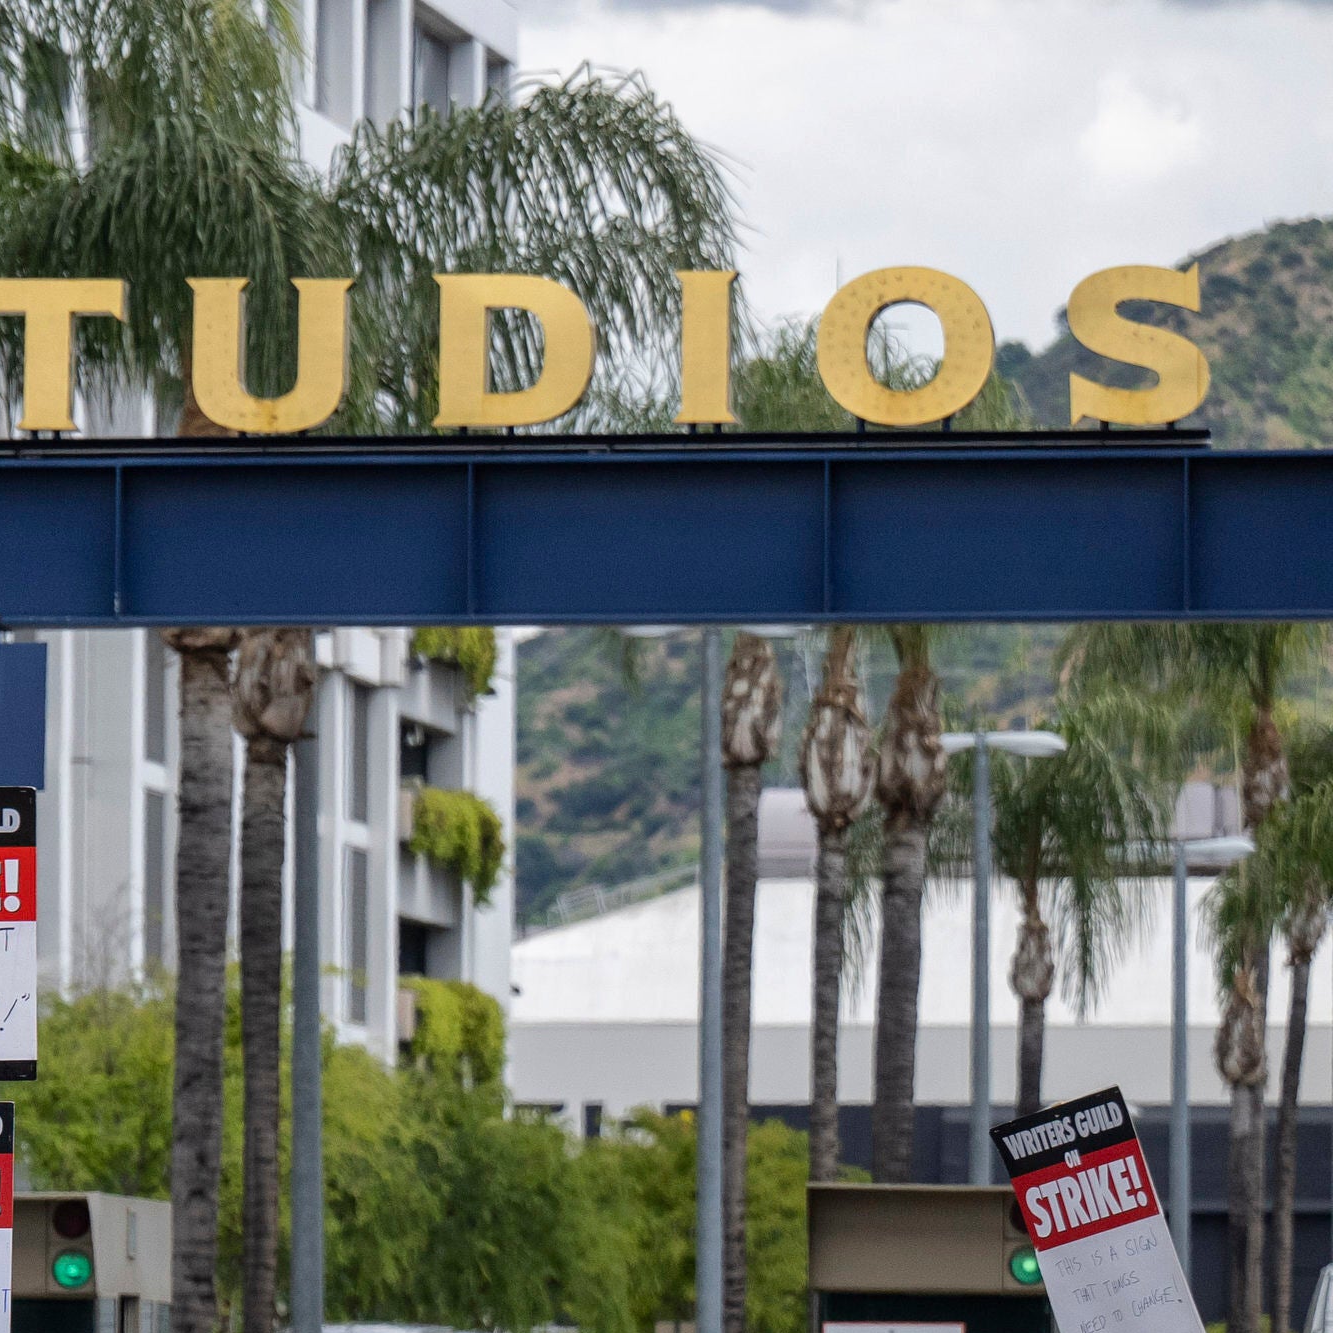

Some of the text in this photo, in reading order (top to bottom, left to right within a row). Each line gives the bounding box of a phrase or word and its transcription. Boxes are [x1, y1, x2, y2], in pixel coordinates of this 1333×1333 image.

[1002, 1101, 1124, 1161] WRITERS GUILD
[1064, 1149, 1082, 1169] ON
[1025, 1155, 1149, 1239] STRIKE!
[1054, 1229, 1158, 1278] THIS IS A SIGN
[1072, 1283, 1096, 1305] THAT
[1112, 1309, 1123, 1323] TO
